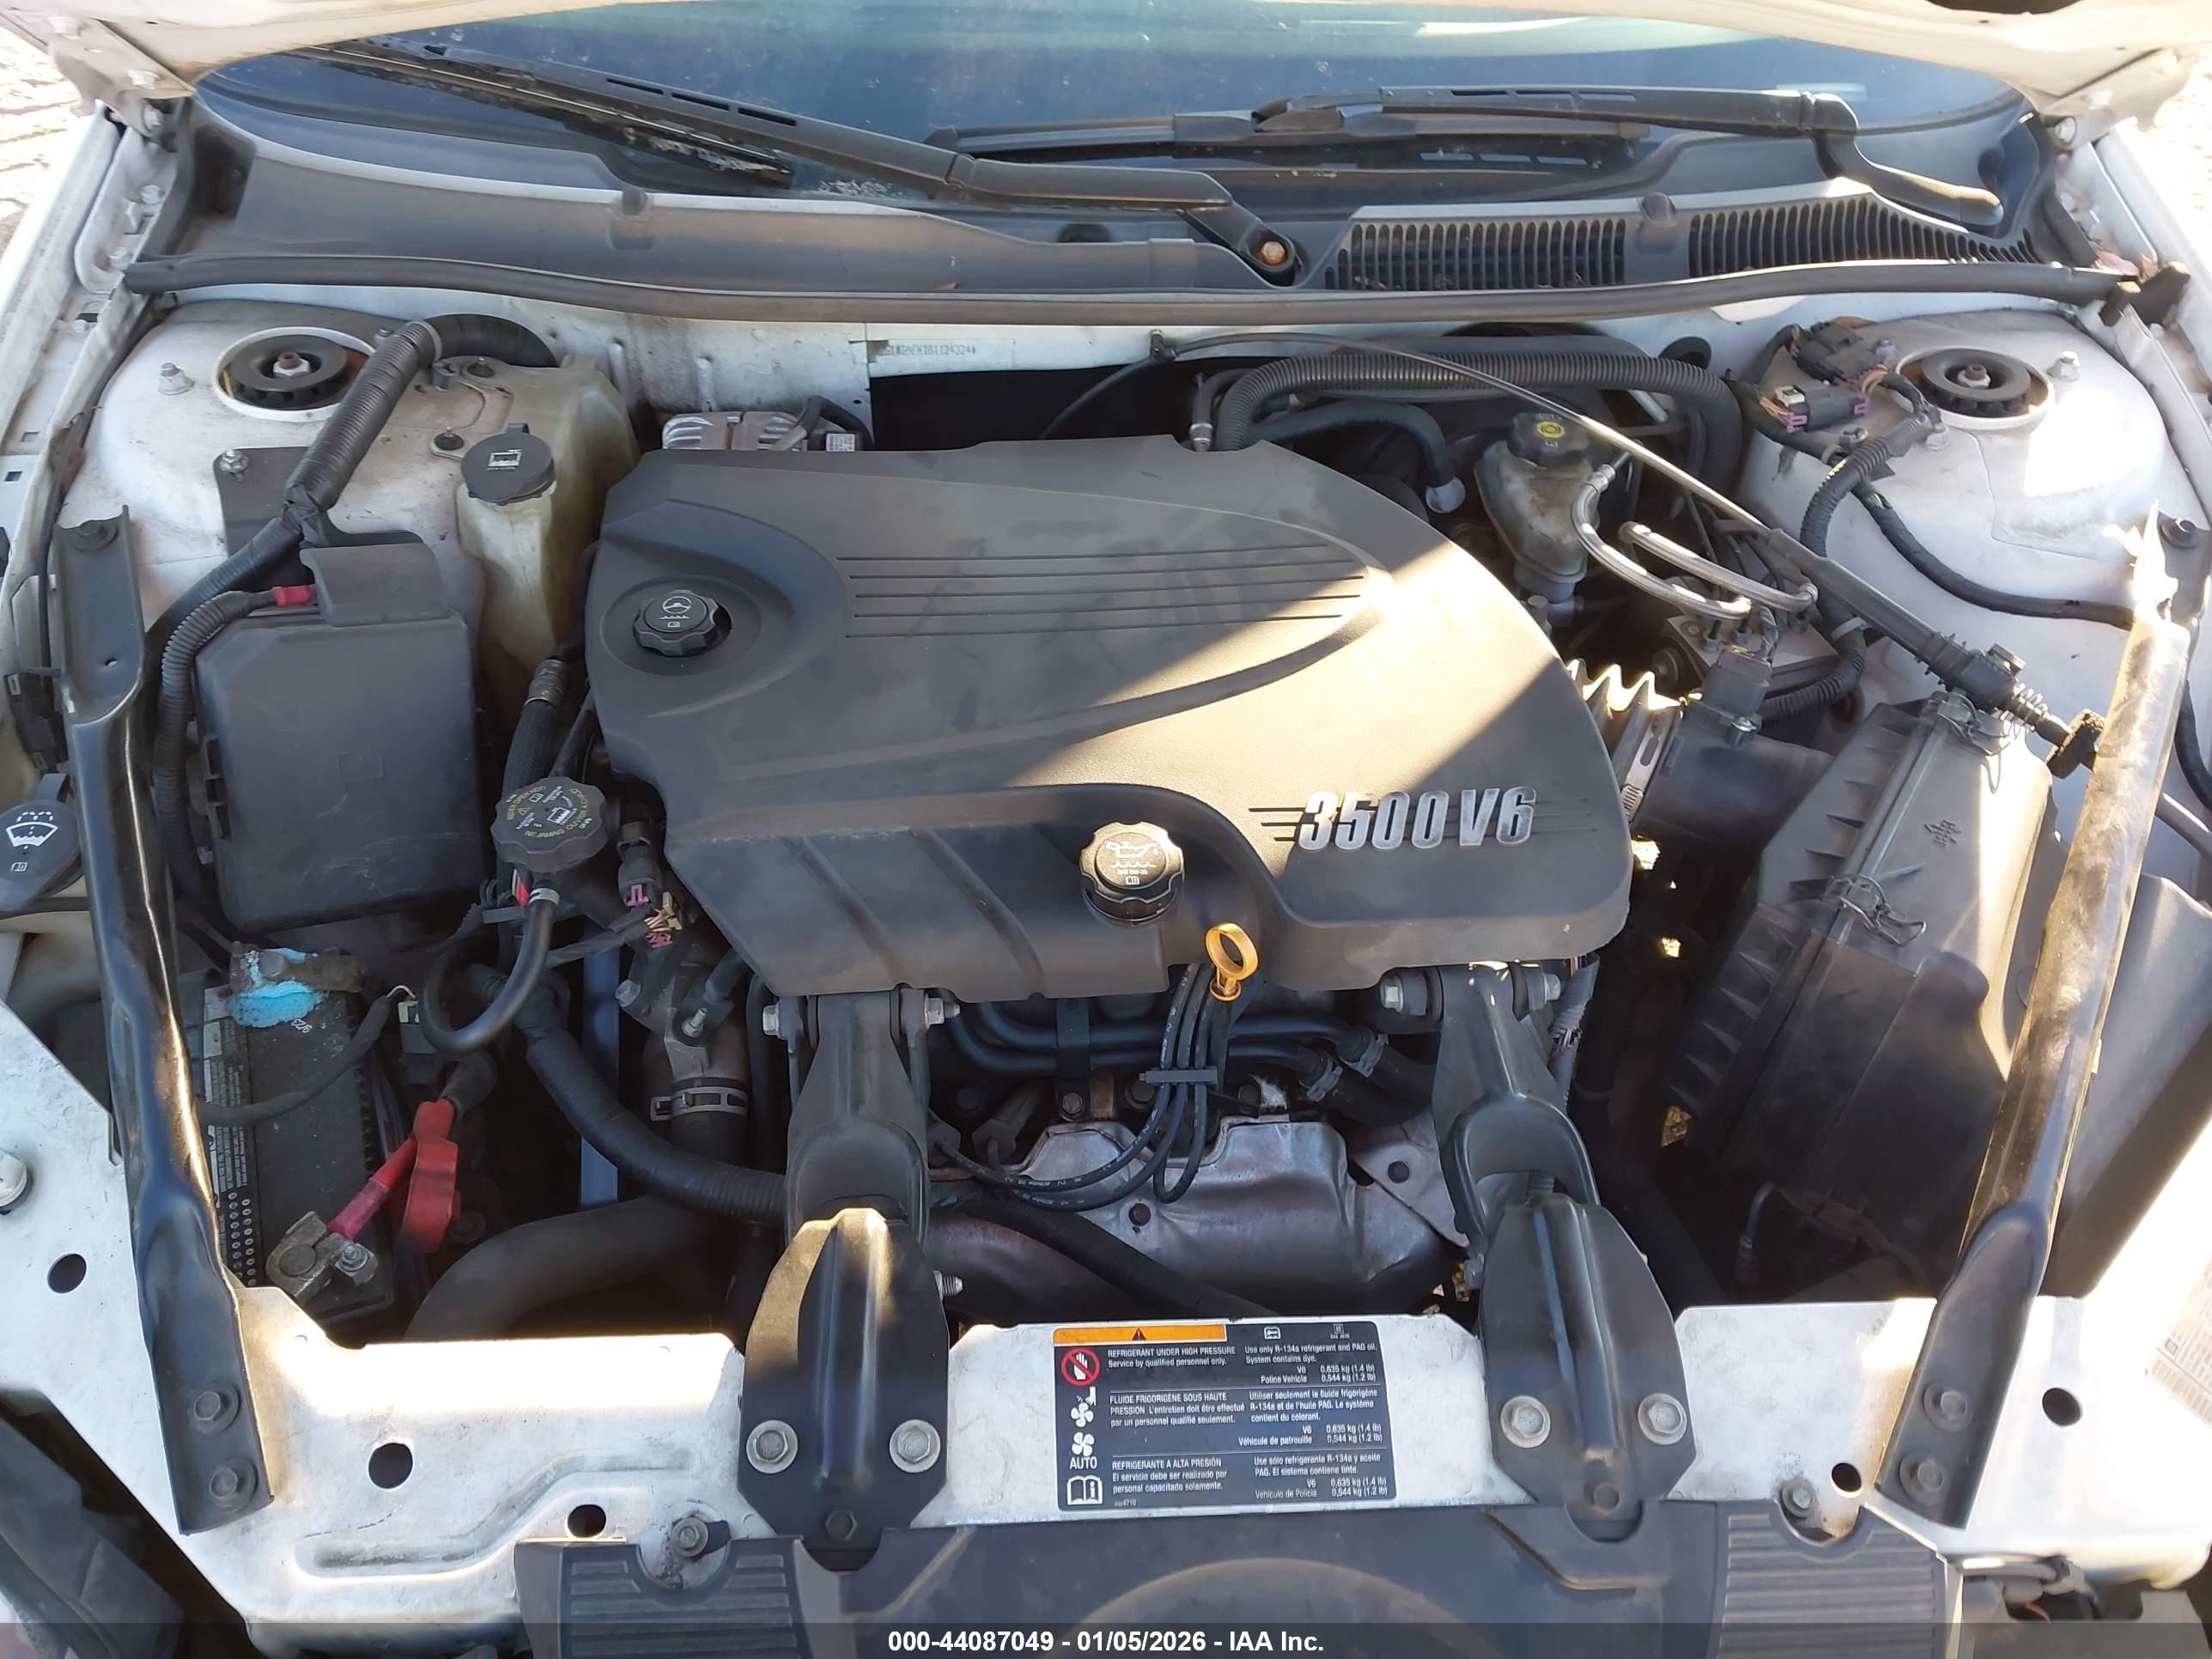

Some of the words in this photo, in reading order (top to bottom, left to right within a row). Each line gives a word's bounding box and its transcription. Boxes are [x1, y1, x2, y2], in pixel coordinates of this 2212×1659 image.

[1298, 790, 1450, 851] 3500
[1458, 787, 1537, 847] V6
[1200, 1346, 1236, 1355] PRESSURE
[1259, 1346, 1273, 1354] only
[1301, 1344, 1336, 1353] refrigerant
[1339, 1343, 1350, 1352] and
[1109, 1359, 1133, 1368] Service
[1135, 1359, 1143, 1368] by
[1146, 1358, 1174, 1368] qualified
[1176, 1358, 1209, 1367] personnel
[1212, 1357, 1226, 1366] only.
[1246, 1356, 1271, 1365] System
[1303, 1354, 1316, 1364] dye.
[1341, 1364, 1350, 1375] kg
[1366, 1364, 1375, 1373] lb)
[1283, 1375, 1307, 1383] Vehicle
[1342, 1374, 1351, 1383] kg
[1367, 1373, 1376, 1382] lb)
[1110, 1395, 1133, 1404] FLUIDE
[1204, 1393, 1227, 1401] HAUTE
[1249, 1391, 1273, 1400] Utiliser
[1275, 1390, 1310, 1399] seulement
[1321, 1389, 1340, 1398] fluide
[1149, 1406, 1185, 1414] L'entretien
[1187, 1404, 1200, 1413] doit
[1201, 1404, 1215, 1413] être
[1250, 1402, 1275, 1411] R-134a
[1285, 1401, 1294, 1410] de
[1318, 1401, 1334, 1409] PAG.
[1335, 1400, 1343, 1409] Le
[1111, 1419, 1122, 1428] par
[1134, 1417, 1169, 1428] personnel
[1198, 1415, 1236, 1425] seulement.
[1251, 1413, 1279, 1422] contient
[1280, 1413, 1290, 1421] du
[1291, 1412, 1321, 1421] colorant.
[1303, 1425, 1312, 1434] V6
[1347, 1425, 1356, 1434] kg
[1372, 1424, 1381, 1432] lb)
[1270, 1436, 1278, 1445] de
[1280, 1435, 1312, 1446] patrouille
[1348, 1434, 1357, 1443] kg
[1373, 1433, 1382, 1443] lb)
[1070, 1457, 1097, 1470] AUTO
[1112, 1461, 1164, 1470] REFRIGERANTE
[1173, 1460, 1189, 1468] ALTA
[1255, 1456, 1267, 1465] Use
[1285, 1455, 1325, 1465] refrigerante
[1328, 1454, 1352, 1462] R-134a
[1353, 1455, 1358, 1463] y
[1360, 1454, 1381, 1462] aceite
[1121, 1473, 1148, 1481] servicio
[1151, 1472, 1167, 1480] debe
[1182, 1471, 1213, 1480] realizado
[1216, 1470, 1227, 1480] por
[1255, 1468, 1271, 1477] PAG.
[1273, 1468, 1279, 1476] El
[1310, 1467, 1339, 1475] contiene
[1341, 1466, 1358, 1474] tinte.
[1307, 1479, 1316, 1487] V6
[1352, 1478, 1361, 1487] kg
[1377, 1477, 1386, 1486] lb)
[1114, 1485, 1143, 1495] personal
[1145, 1483, 1183, 1493] capacitado
[1185, 1482, 1223, 1491] solamente.
[1285, 1489, 1294, 1498] de
[1352, 1487, 1362, 1497] kg
[1378, 1486, 1388, 1496] lb)
